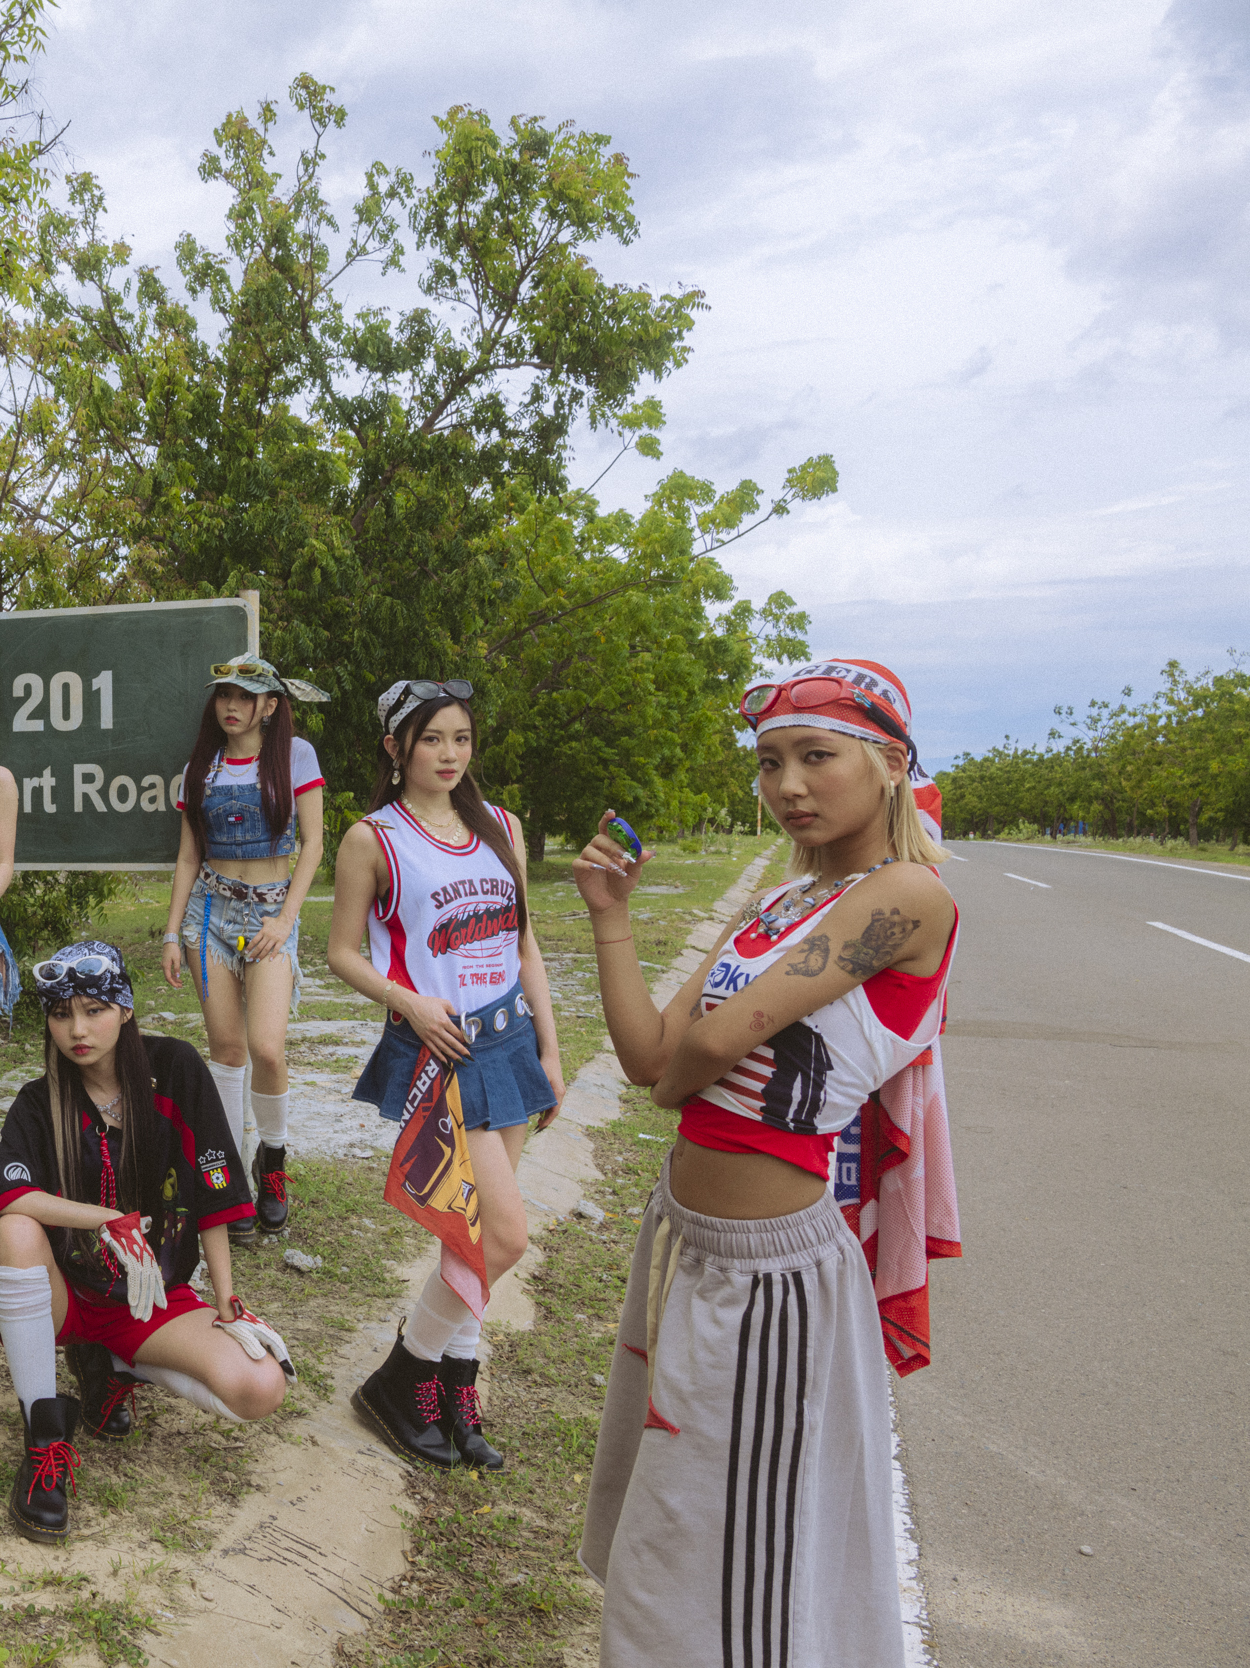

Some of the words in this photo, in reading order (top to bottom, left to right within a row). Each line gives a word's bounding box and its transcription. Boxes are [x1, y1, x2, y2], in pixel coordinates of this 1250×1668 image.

[781, 664, 897, 706] GERS
[17, 765, 57, 814] rt
[430, 878, 479, 910] SANTA
[480, 877, 517, 904] CRUZ
[470, 972, 488, 988] THE
[396, 1058, 440, 1134] RACIN
